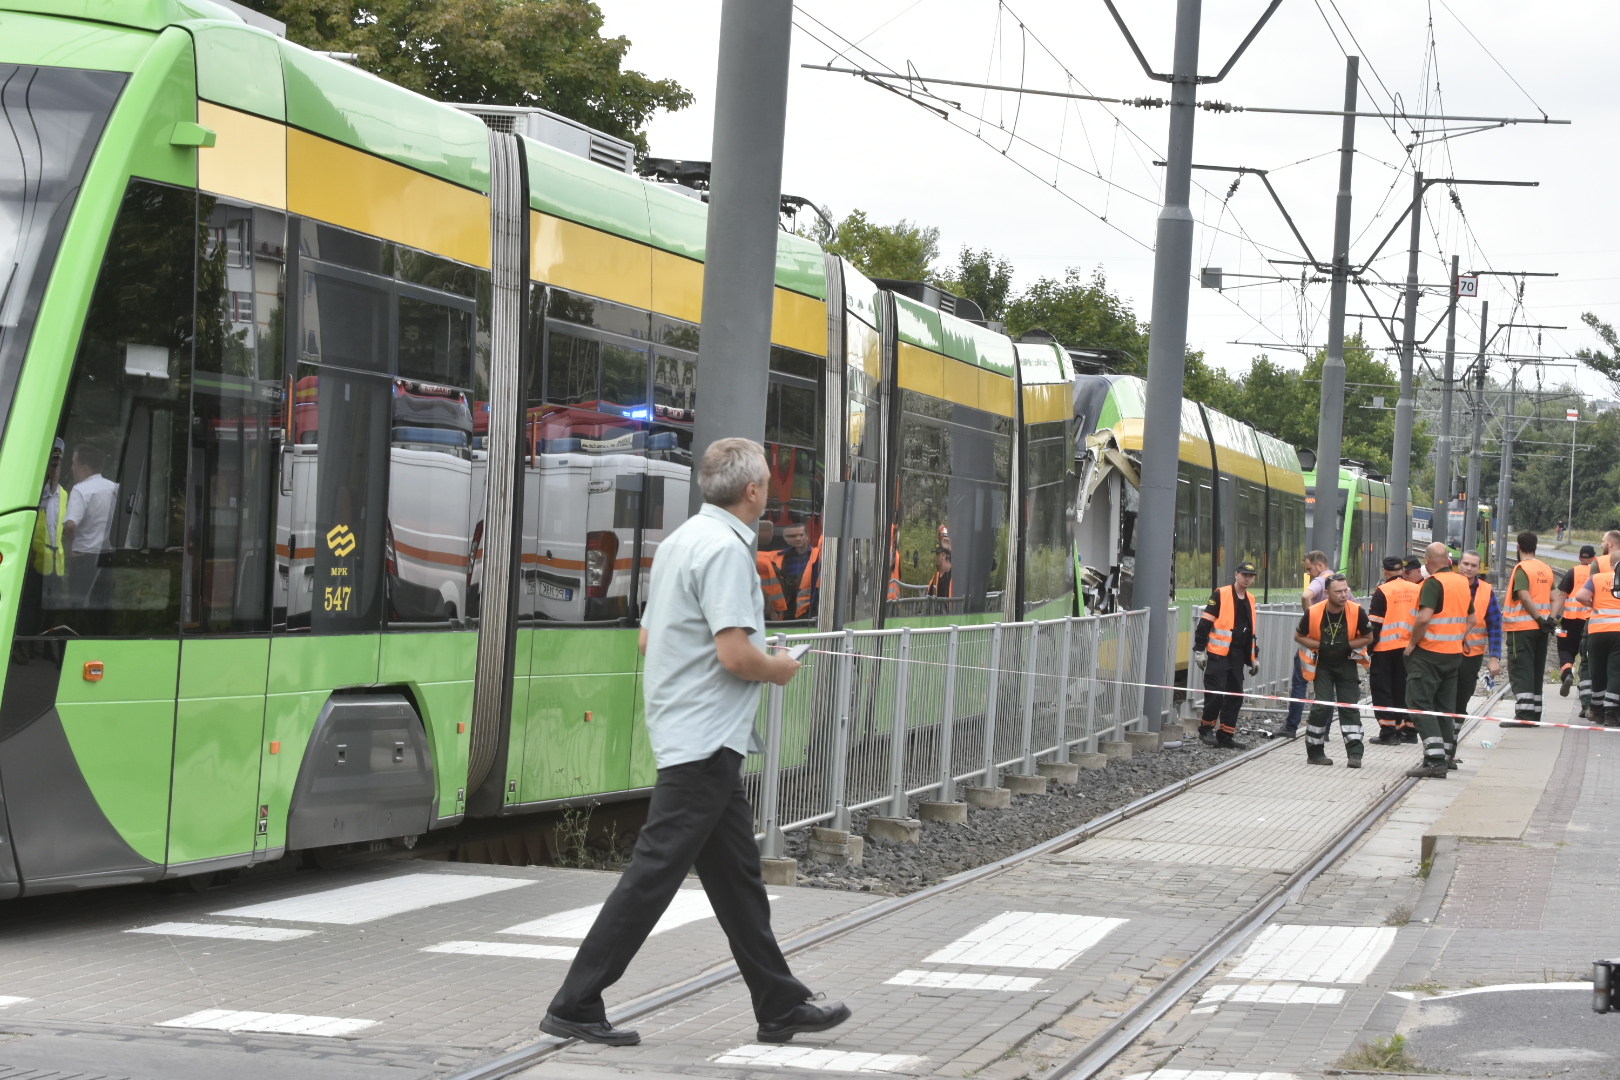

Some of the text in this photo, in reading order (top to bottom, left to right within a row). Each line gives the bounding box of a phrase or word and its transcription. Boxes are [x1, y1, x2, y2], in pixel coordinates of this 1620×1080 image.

[1461, 281, 1474, 291] 70
[1458, 492, 1466, 500] 11
[330, 567, 348, 576] MPK
[324, 586, 352, 611] 547
